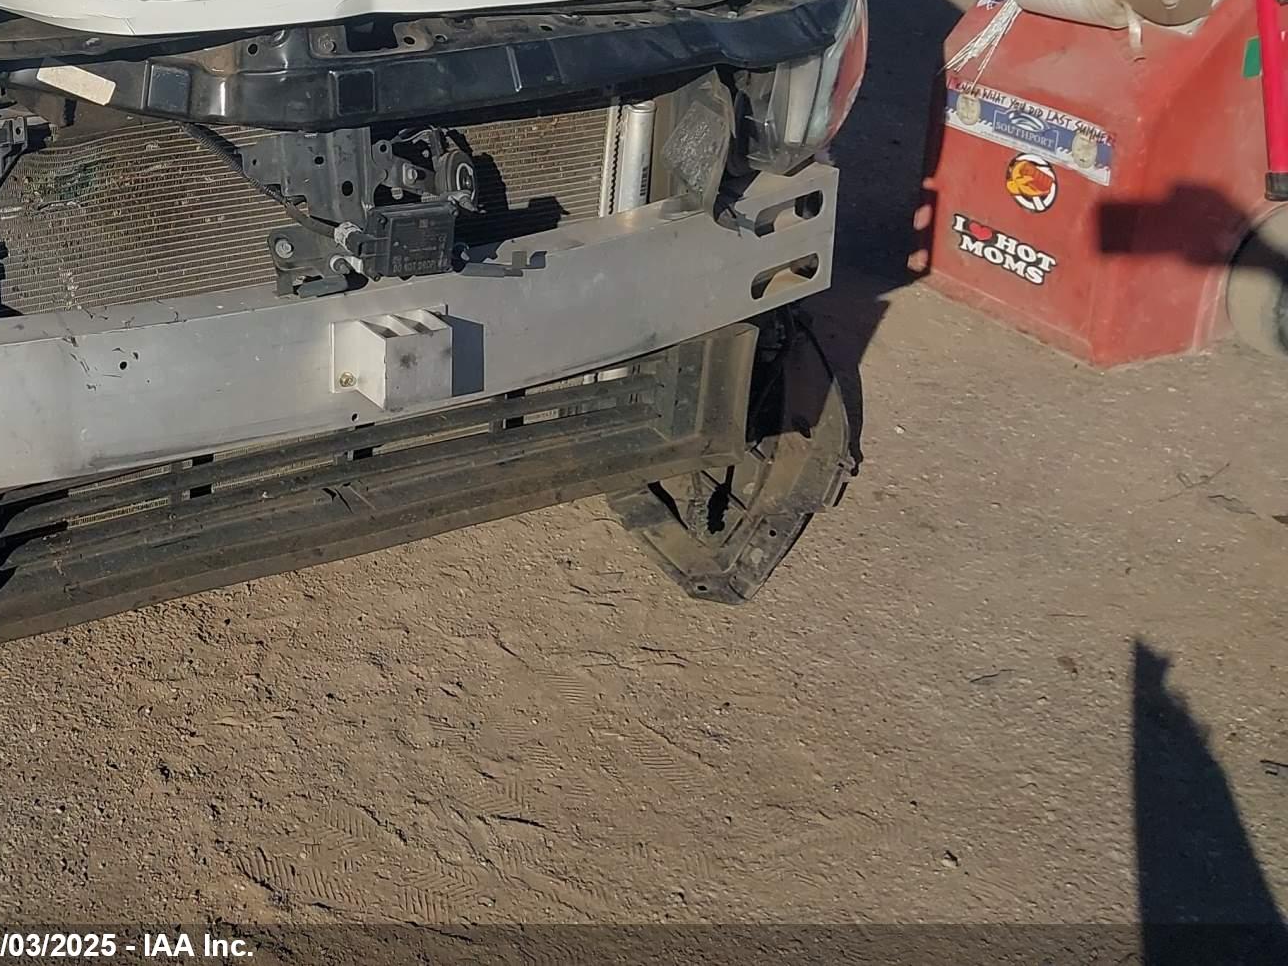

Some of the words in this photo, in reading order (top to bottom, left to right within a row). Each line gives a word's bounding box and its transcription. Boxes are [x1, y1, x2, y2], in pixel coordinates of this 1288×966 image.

[982, 89, 1006, 106] WHAT
[1009, 98, 1026, 112] YOU
[1028, 104, 1044, 119] DID
[1046, 110, 1073, 128] LAST
[995, 121, 1055, 148] SOUTHPORT
[953, 215, 967, 232] I
[995, 233, 1057, 272] HOT
[960, 235, 1044, 284] MOMS
